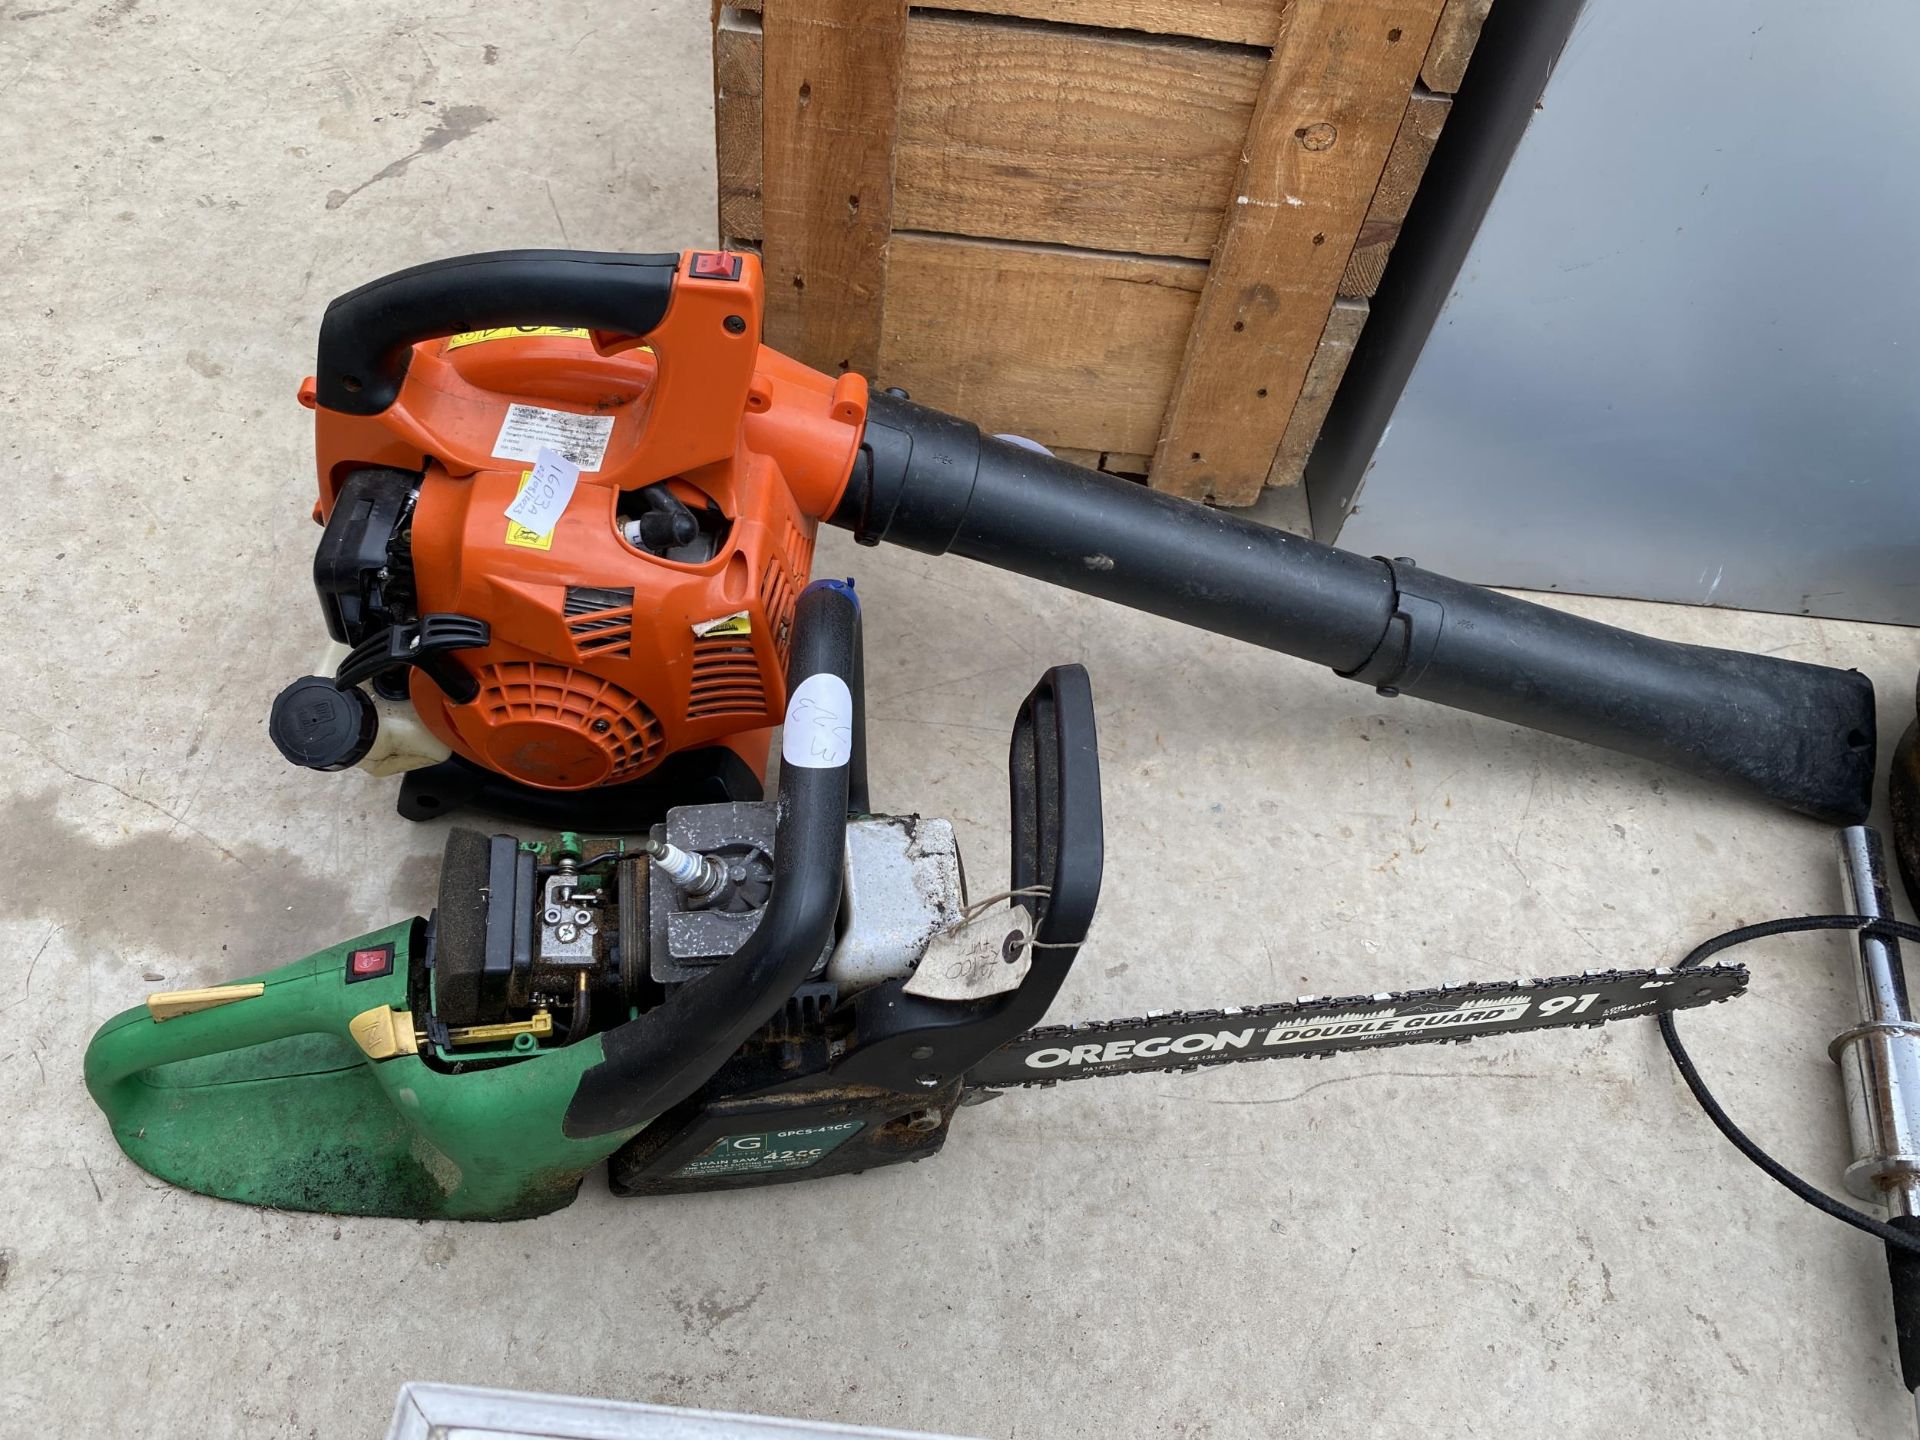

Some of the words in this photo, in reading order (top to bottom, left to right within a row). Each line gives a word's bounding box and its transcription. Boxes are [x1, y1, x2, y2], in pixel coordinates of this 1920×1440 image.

[1538, 993, 1601, 1019] 91
[1276, 1020, 1395, 1042] DOUBLE
[1403, 1009, 1505, 1029] GUARD
[1404, 1029, 1425, 1037] USA
[1025, 1028, 1256, 1069] OREGON
[733, 1137, 761, 1150] G
[691, 1159, 729, 1167] CHAIN
[732, 1156, 760, 1164] SAW
